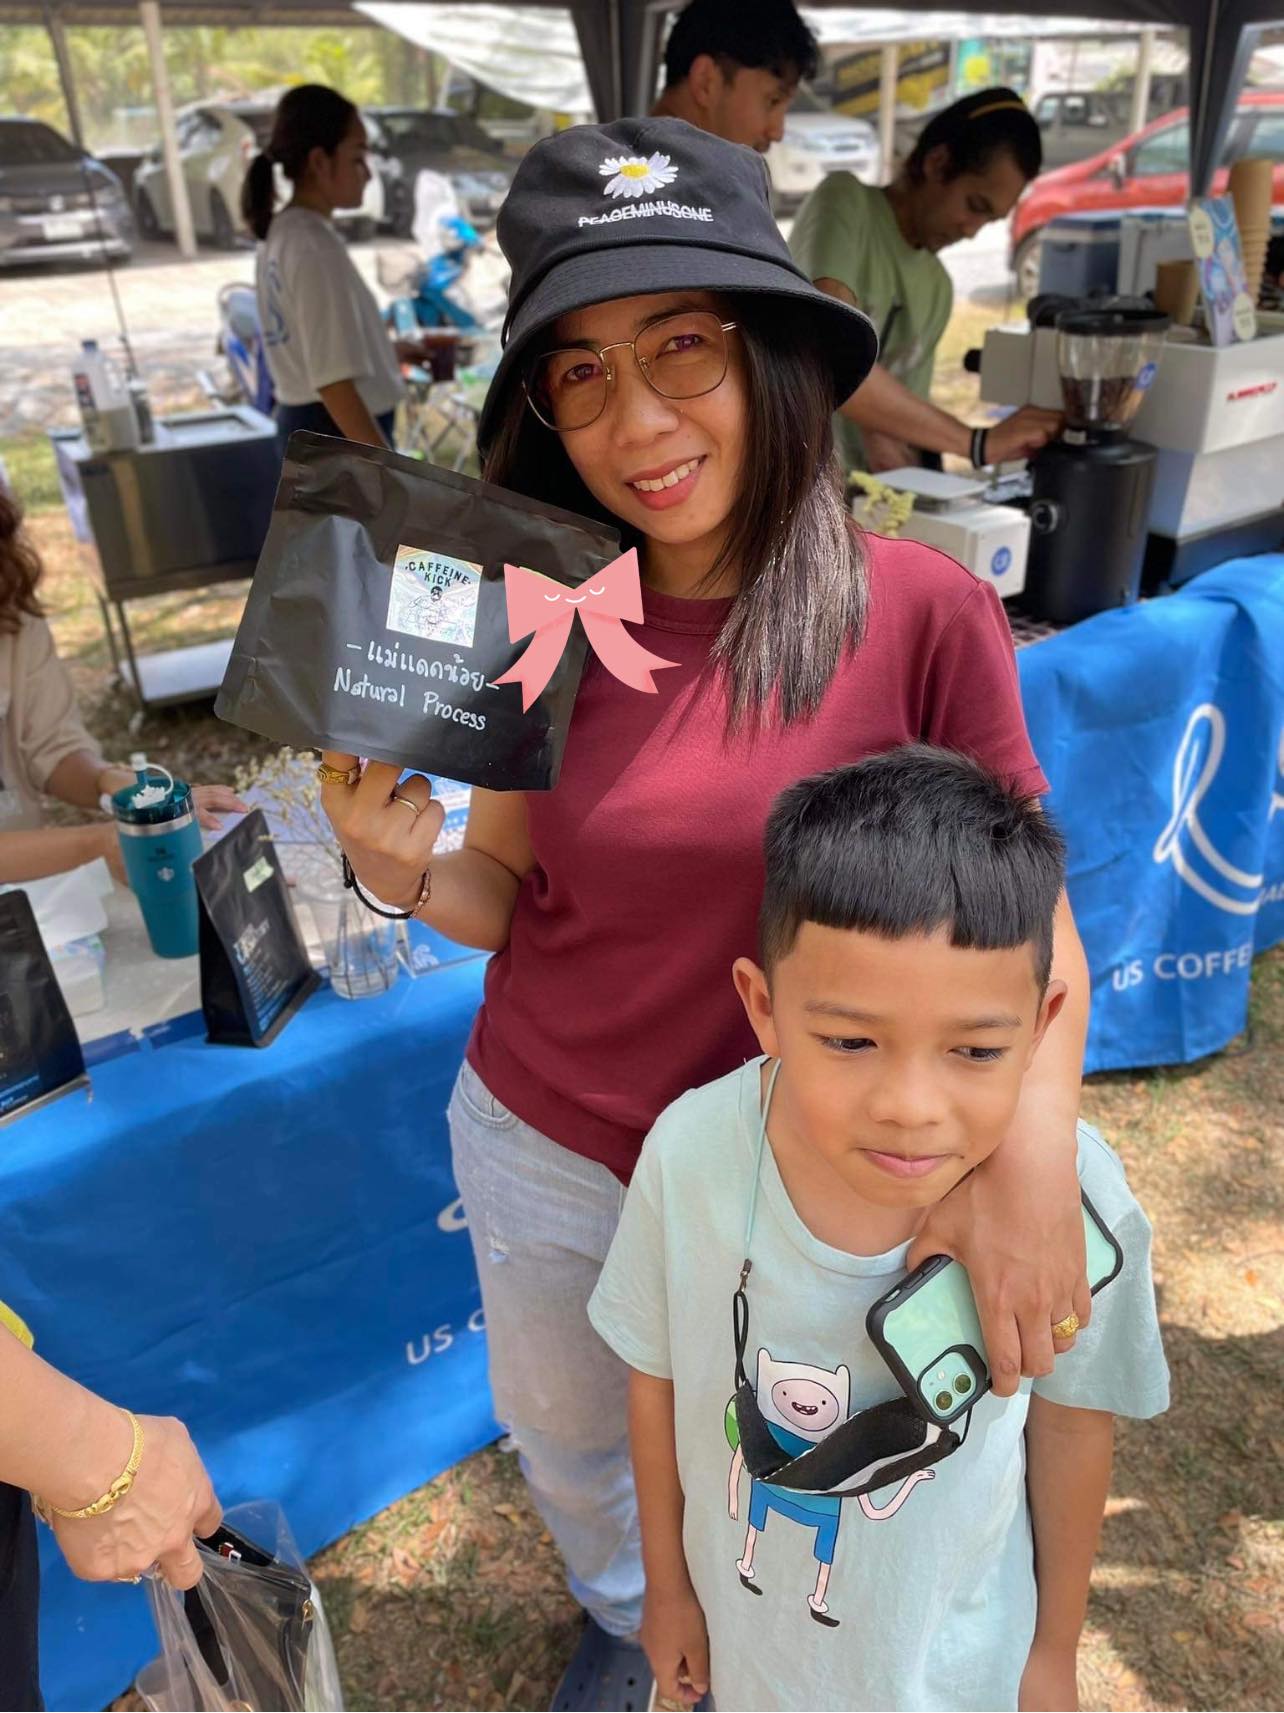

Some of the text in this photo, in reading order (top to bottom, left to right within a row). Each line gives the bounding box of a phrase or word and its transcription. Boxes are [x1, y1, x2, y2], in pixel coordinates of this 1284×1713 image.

[424, 572, 452, 588] KICK
[333, 666, 487, 731] Natural Process
[1112, 959, 1144, 992] US
[406, 1323, 455, 1365] US
